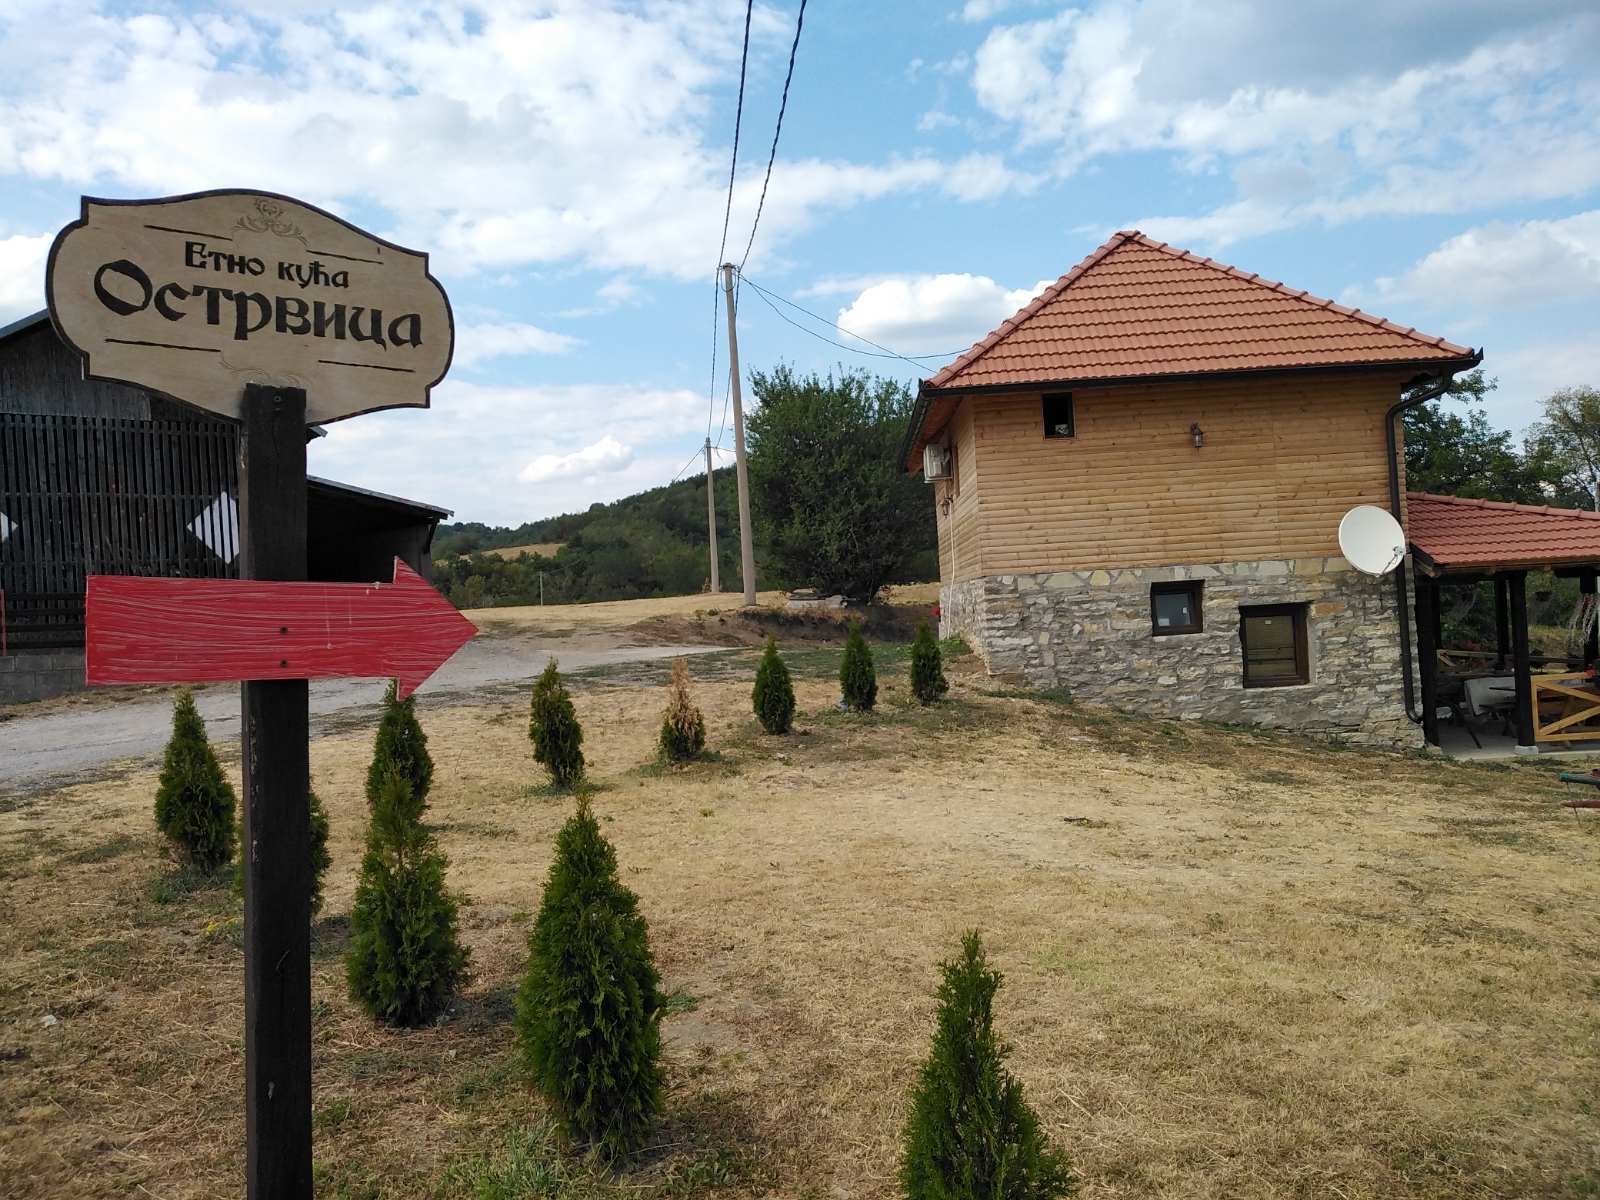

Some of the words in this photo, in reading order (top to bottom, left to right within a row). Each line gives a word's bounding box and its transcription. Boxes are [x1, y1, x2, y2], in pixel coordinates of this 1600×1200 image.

[185, 241, 265, 276] Етно
[277, 260, 349, 289] кућа
[93, 259, 423, 352] Острвица
